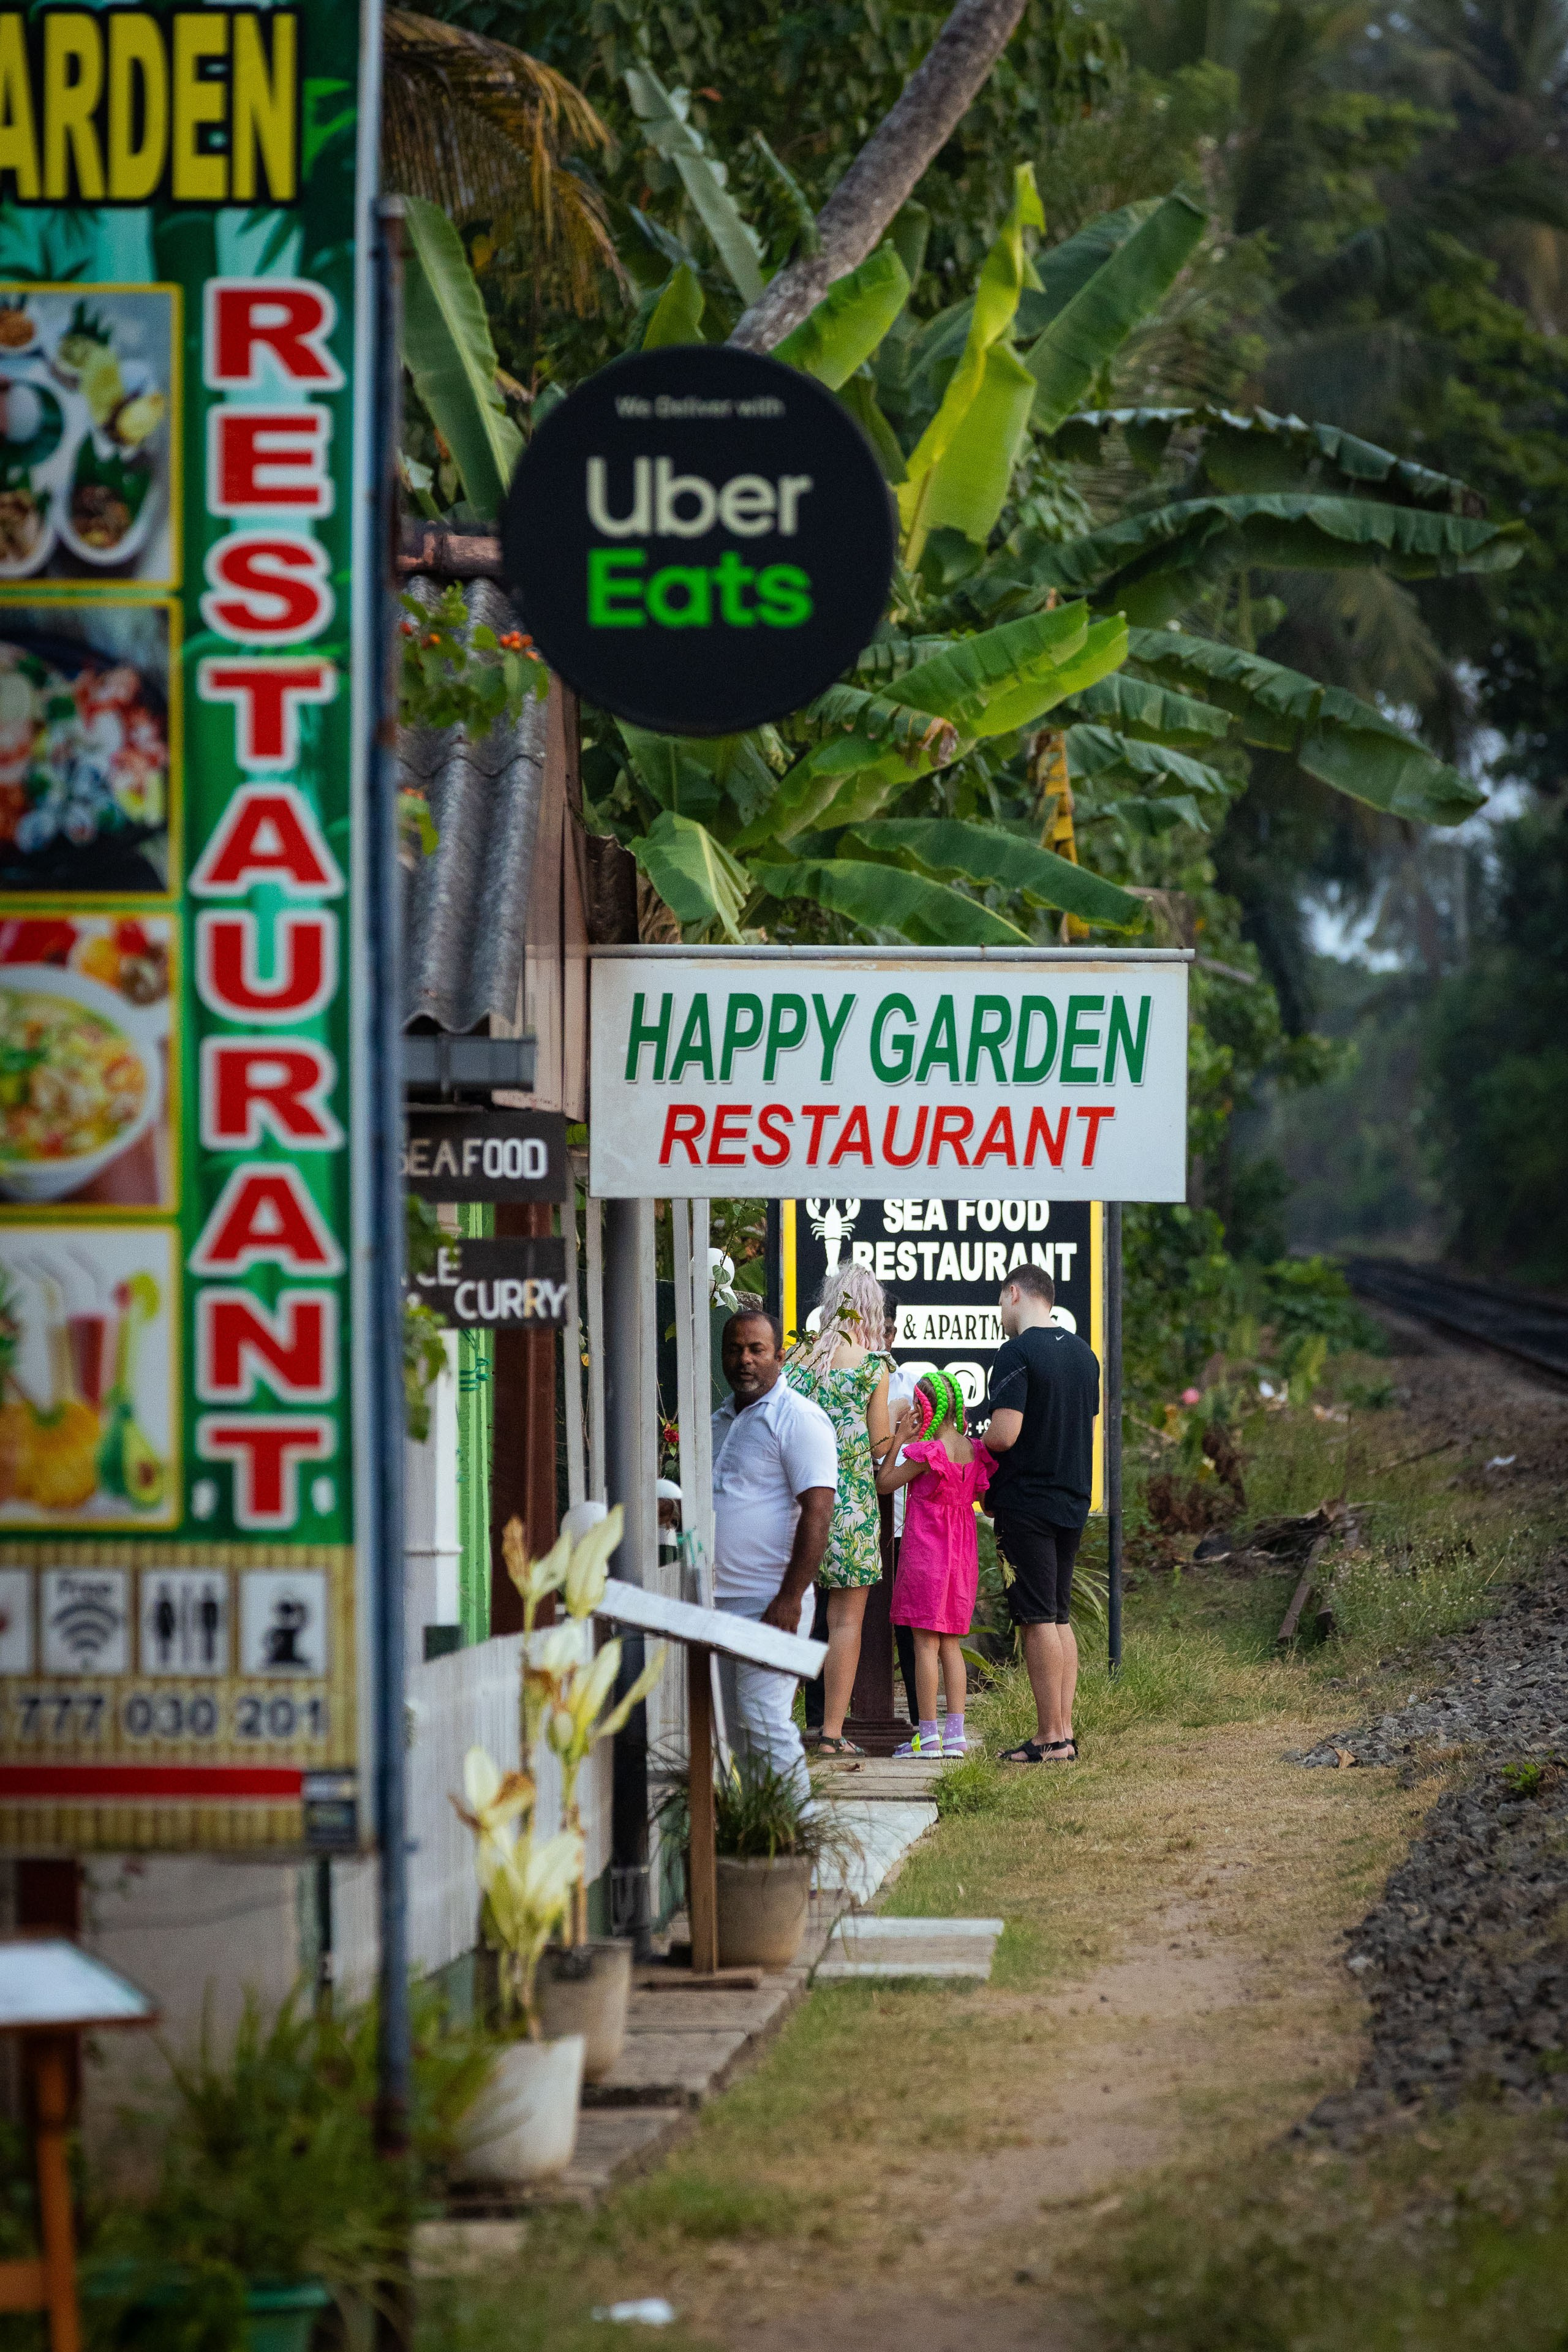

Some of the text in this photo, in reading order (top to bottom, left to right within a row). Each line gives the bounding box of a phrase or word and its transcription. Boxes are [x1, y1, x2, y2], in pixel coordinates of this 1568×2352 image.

[586, 455, 814, 538] Uber
[586, 547, 813, 628] Eats
[202, 285, 334, 1515] RESTAURANT
[624, 992, 1153, 1085] HAPPY GARDEN
[658, 1103, 1117, 1169] RESTAURANT
[883, 1199, 1049, 1233] SEA FOOD
[852, 1241, 1077, 1282] RESTAURANT
[453, 1278, 567, 1320] CURRY
[903, 1314, 918, 1340] &
